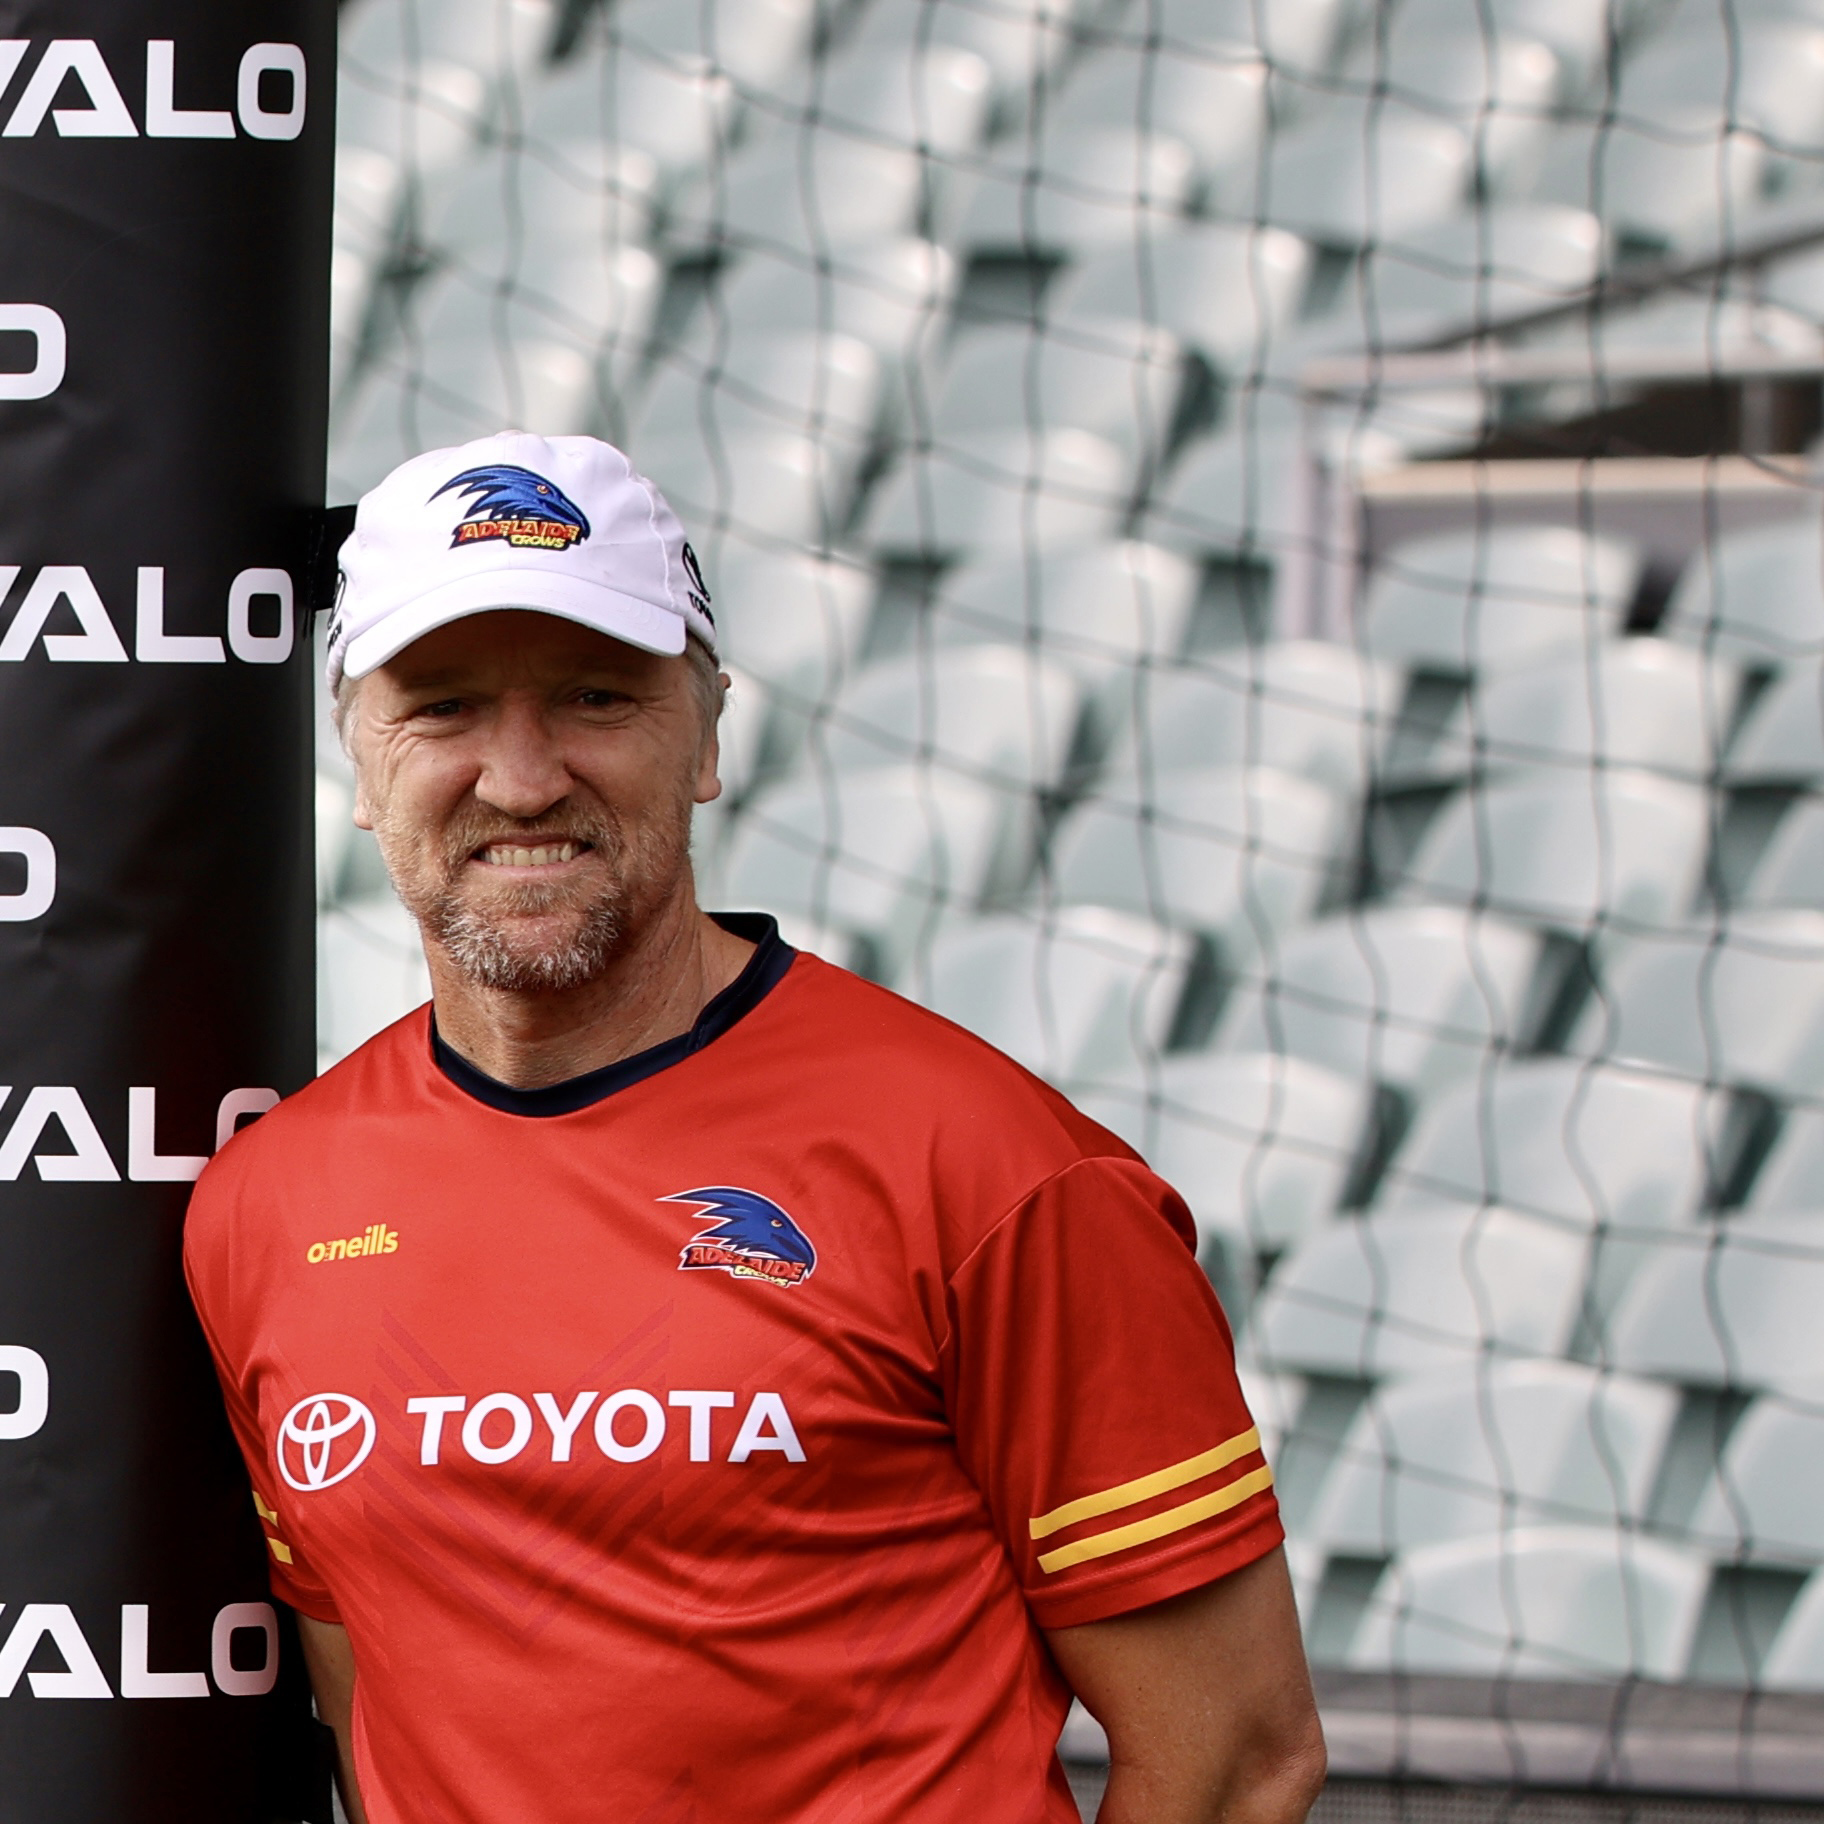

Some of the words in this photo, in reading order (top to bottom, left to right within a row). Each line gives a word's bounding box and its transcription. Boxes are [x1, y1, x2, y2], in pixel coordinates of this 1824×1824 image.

[458, 520, 580, 542] ADELAIDE
[510, 534, 566, 548] CROWS
[687, 1246, 806, 1280] ADELAIDE
[406, 1388, 808, 1466] TOYOTA
